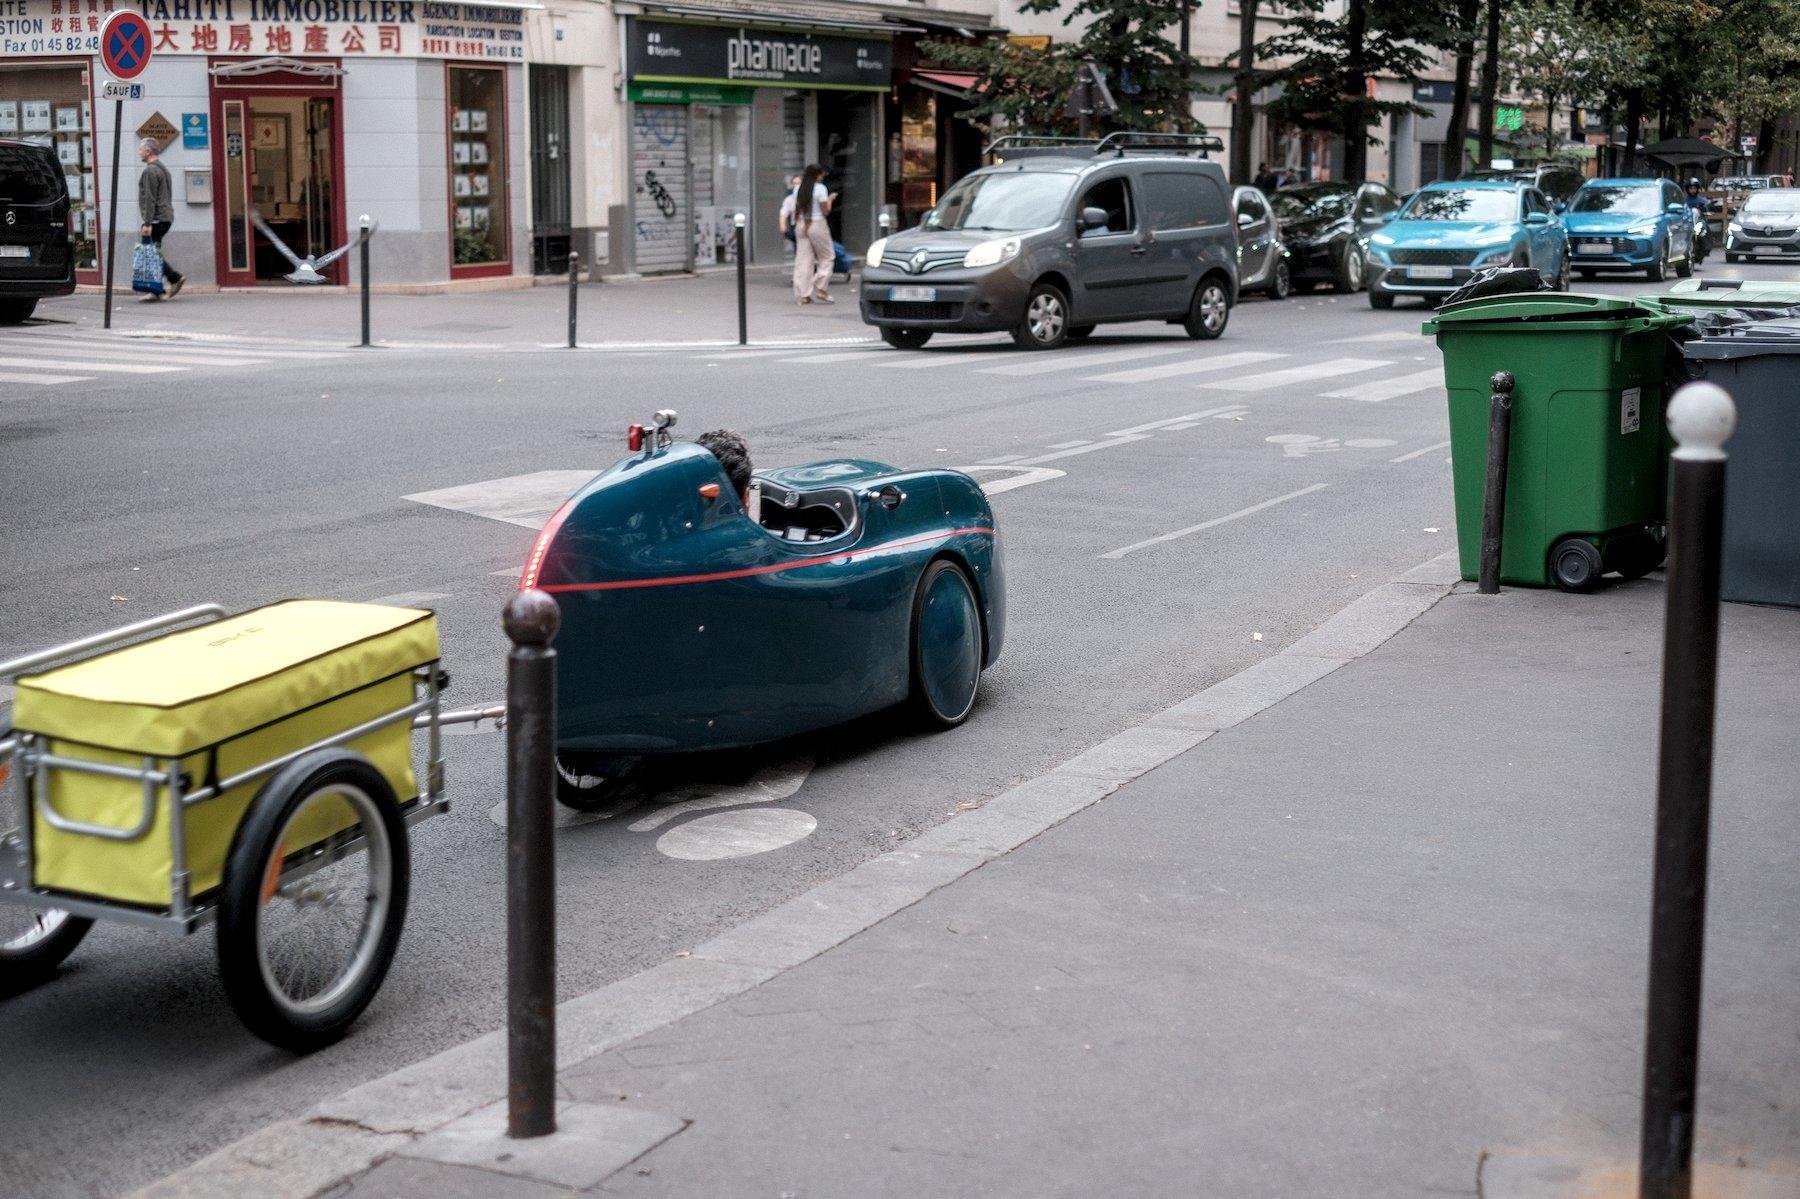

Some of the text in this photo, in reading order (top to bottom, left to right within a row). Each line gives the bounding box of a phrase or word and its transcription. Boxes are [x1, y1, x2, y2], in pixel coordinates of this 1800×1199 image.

[137, 0, 416, 23] TAHITI IMMOBILIER
[5, 39, 27, 52] Fax
[32, 39, 44, 52] 01
[47, 38, 62, 51] 45
[66, 37, 82, 51] 82
[153, 22, 401, 53] 大地房地產公司
[727, 28, 822, 79] pharmacie
[107, 86, 130, 96] SAUF
